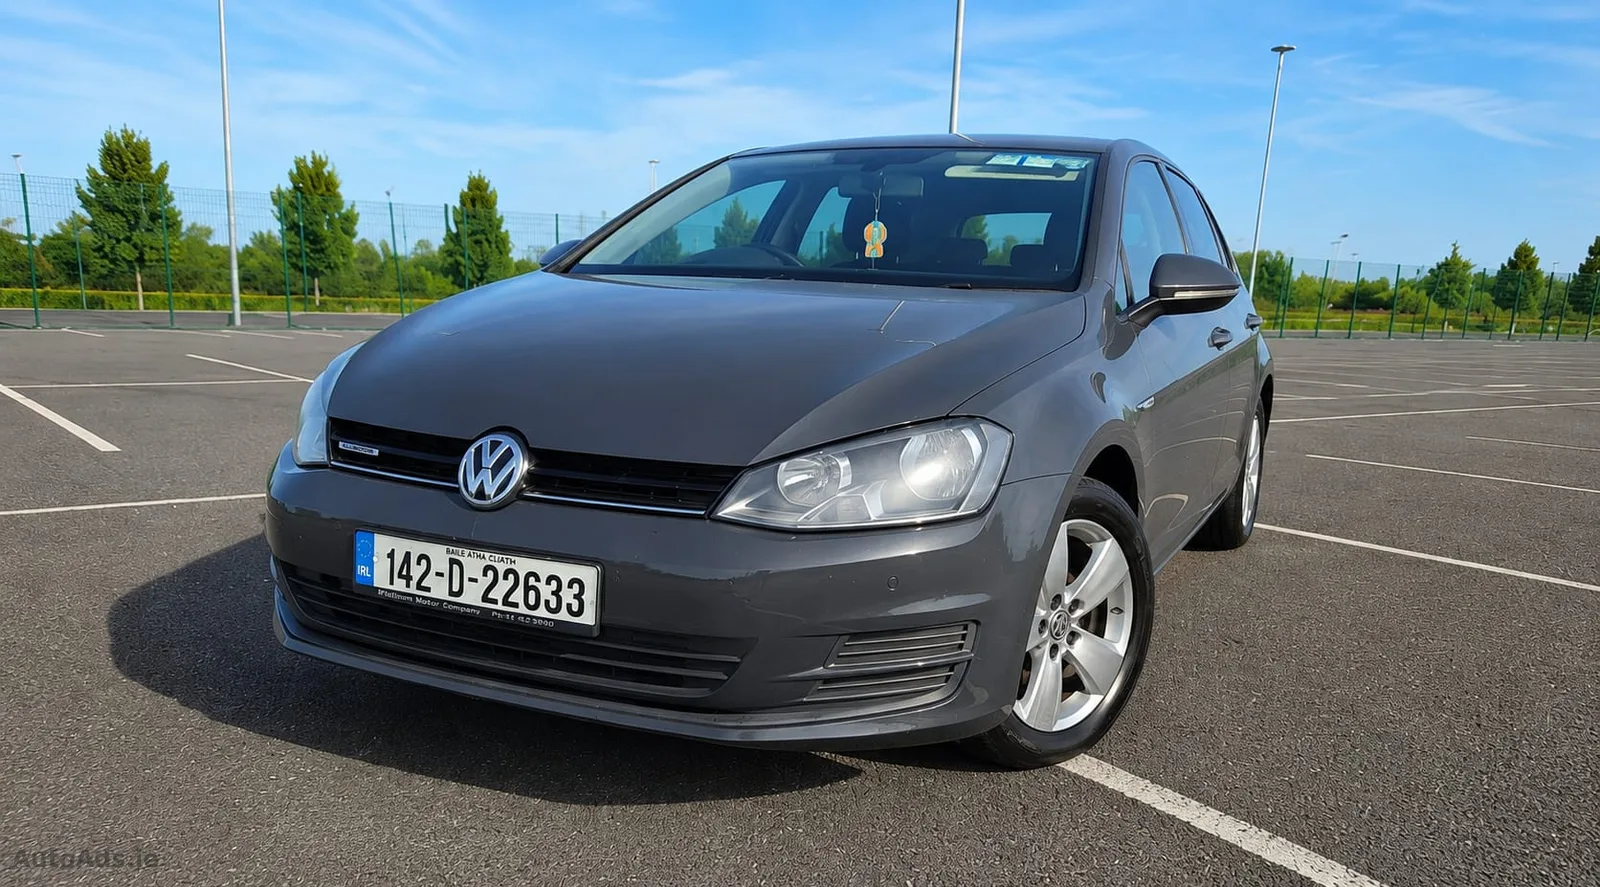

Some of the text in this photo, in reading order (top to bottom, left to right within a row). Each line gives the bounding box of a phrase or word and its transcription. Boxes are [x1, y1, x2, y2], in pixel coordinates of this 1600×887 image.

[446, 548, 517, 566] BAILE ATHA CLIATH
[357, 564, 372, 577] IRL
[386, 548, 586, 618] 142-D-22633
[442, 601, 482, 616] Company
